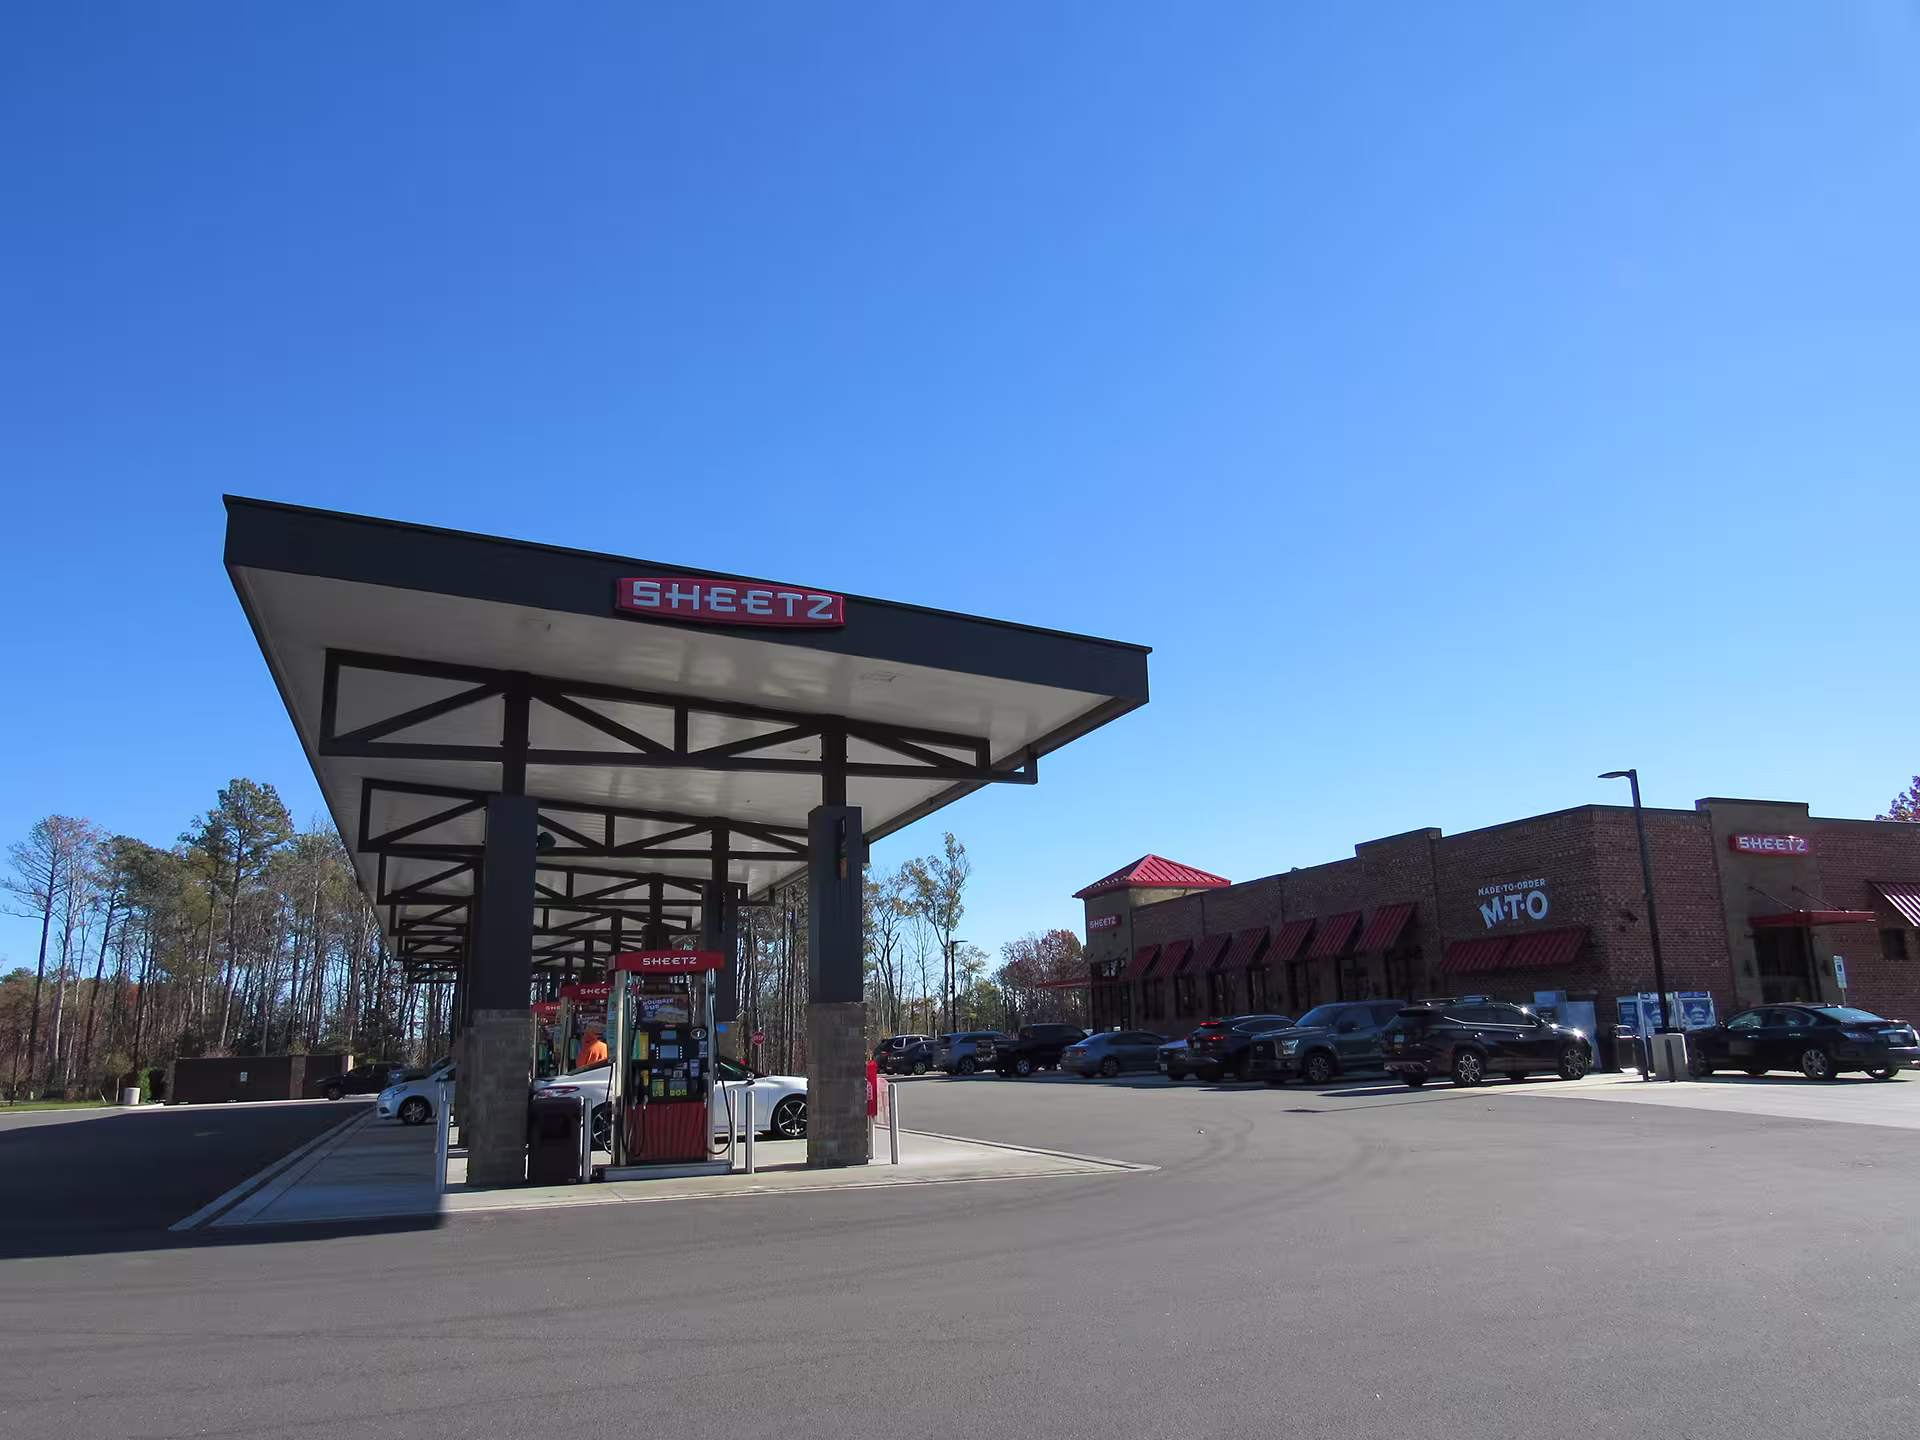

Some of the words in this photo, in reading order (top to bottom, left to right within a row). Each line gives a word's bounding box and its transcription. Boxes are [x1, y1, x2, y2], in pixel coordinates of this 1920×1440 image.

[633, 581, 833, 619] SHEETZ
[1739, 836, 1806, 851] SHEETZ
[1090, 916, 1116, 928] SHEETZ
[642, 956, 697, 966] SHEETZ
